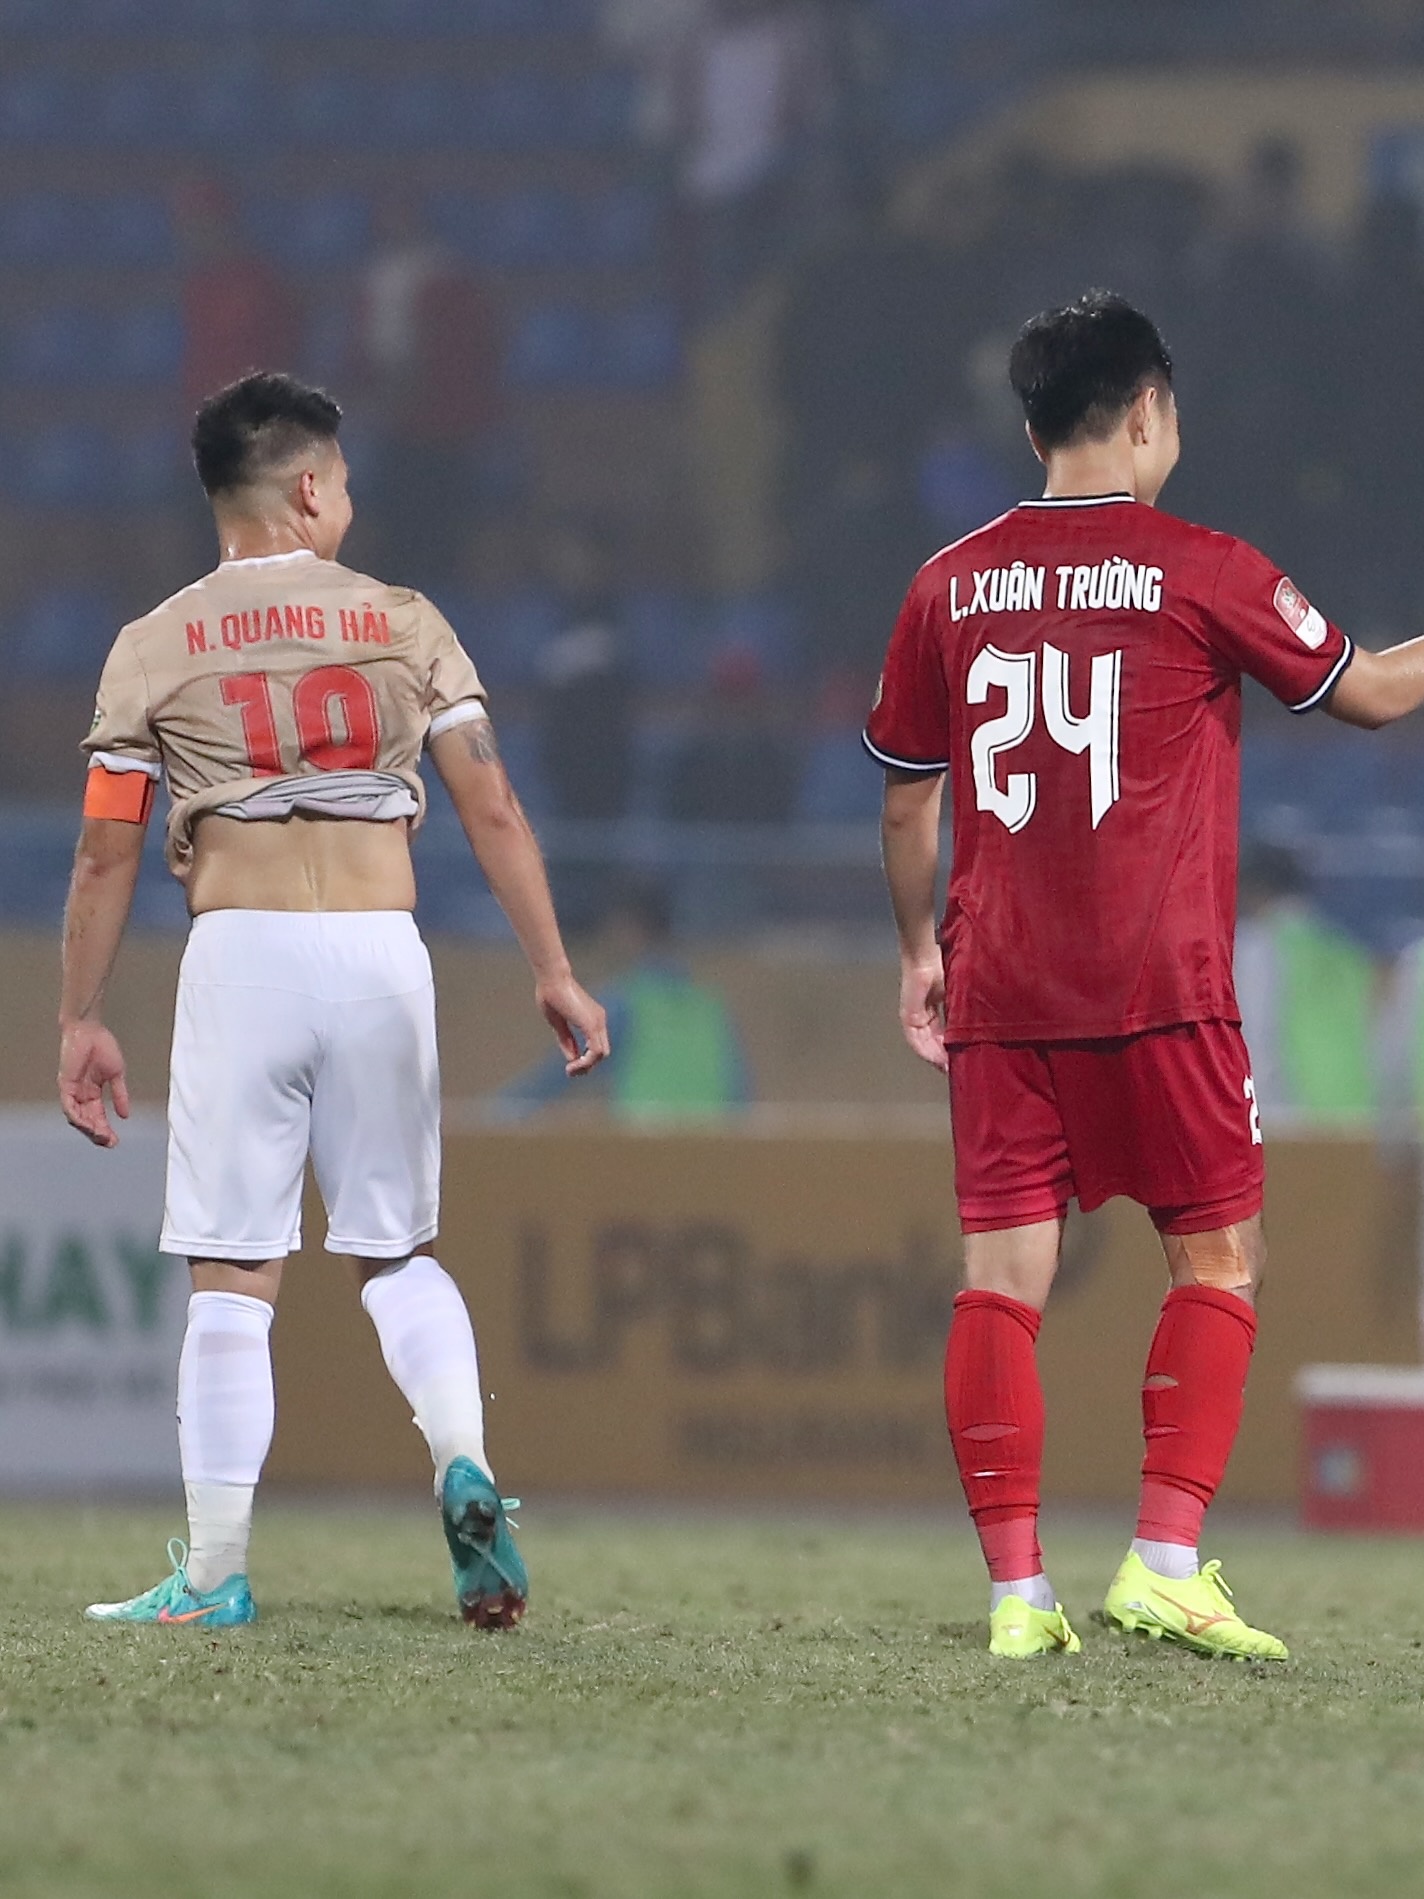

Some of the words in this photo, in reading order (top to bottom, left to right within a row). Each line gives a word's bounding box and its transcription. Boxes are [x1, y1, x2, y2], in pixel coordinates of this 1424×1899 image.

[339, 601, 391, 647] HẢI
[1055, 555, 1164, 613] TRƯỜNG
[219, 664, 379, 778] 10
[966, 641, 1123, 835] 24
